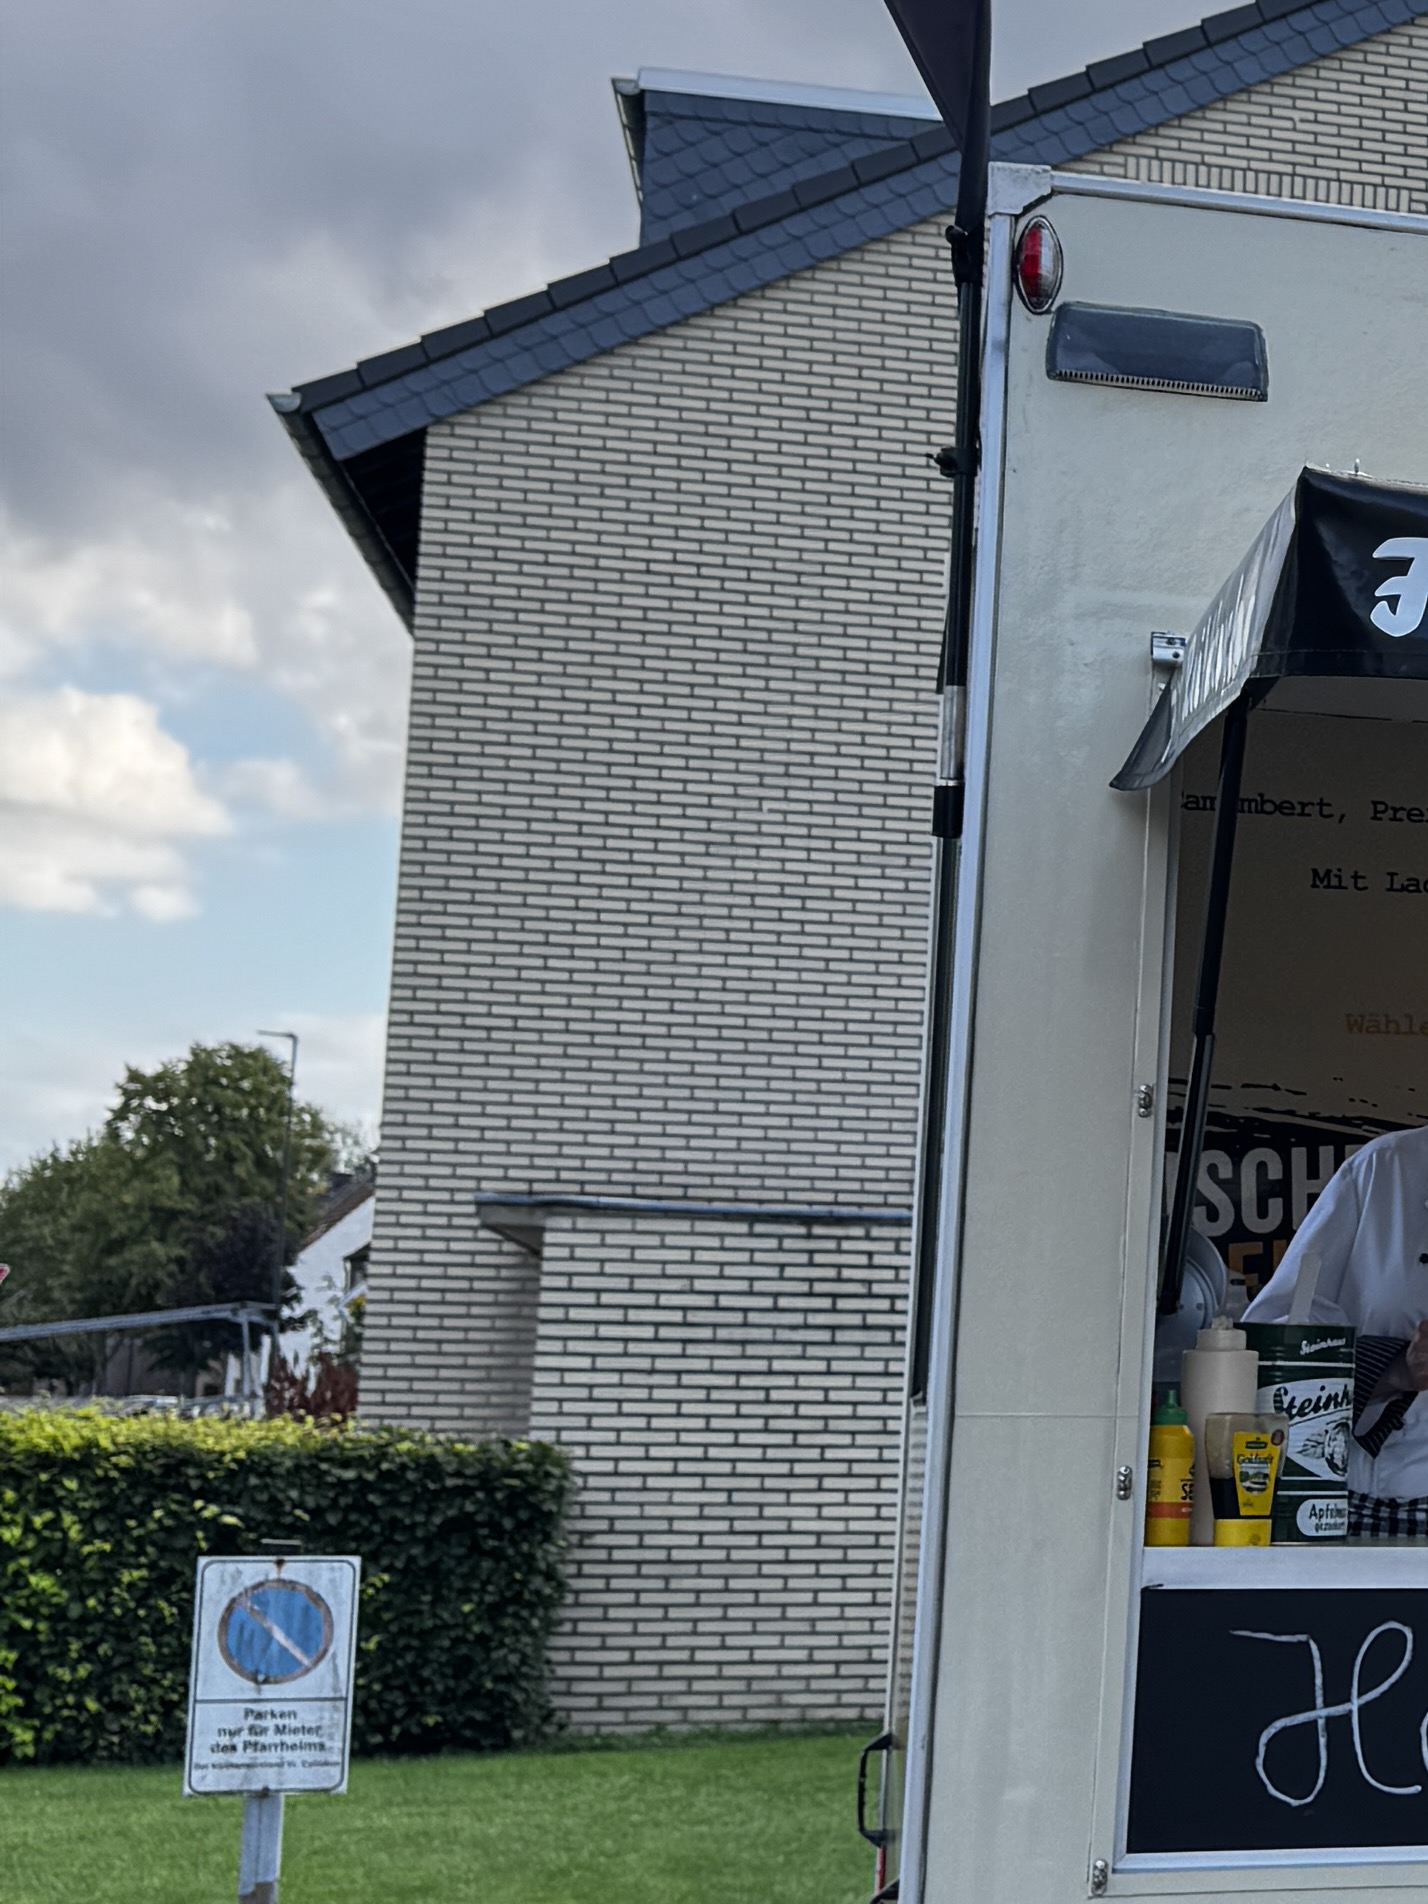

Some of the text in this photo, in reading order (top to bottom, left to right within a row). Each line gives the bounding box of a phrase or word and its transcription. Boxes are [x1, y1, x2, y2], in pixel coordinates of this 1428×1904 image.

[1181, 792, 1346, 823] ammbert,
[1311, 867, 1369, 892] Mit
[244, 1707, 298, 1721] Parken
